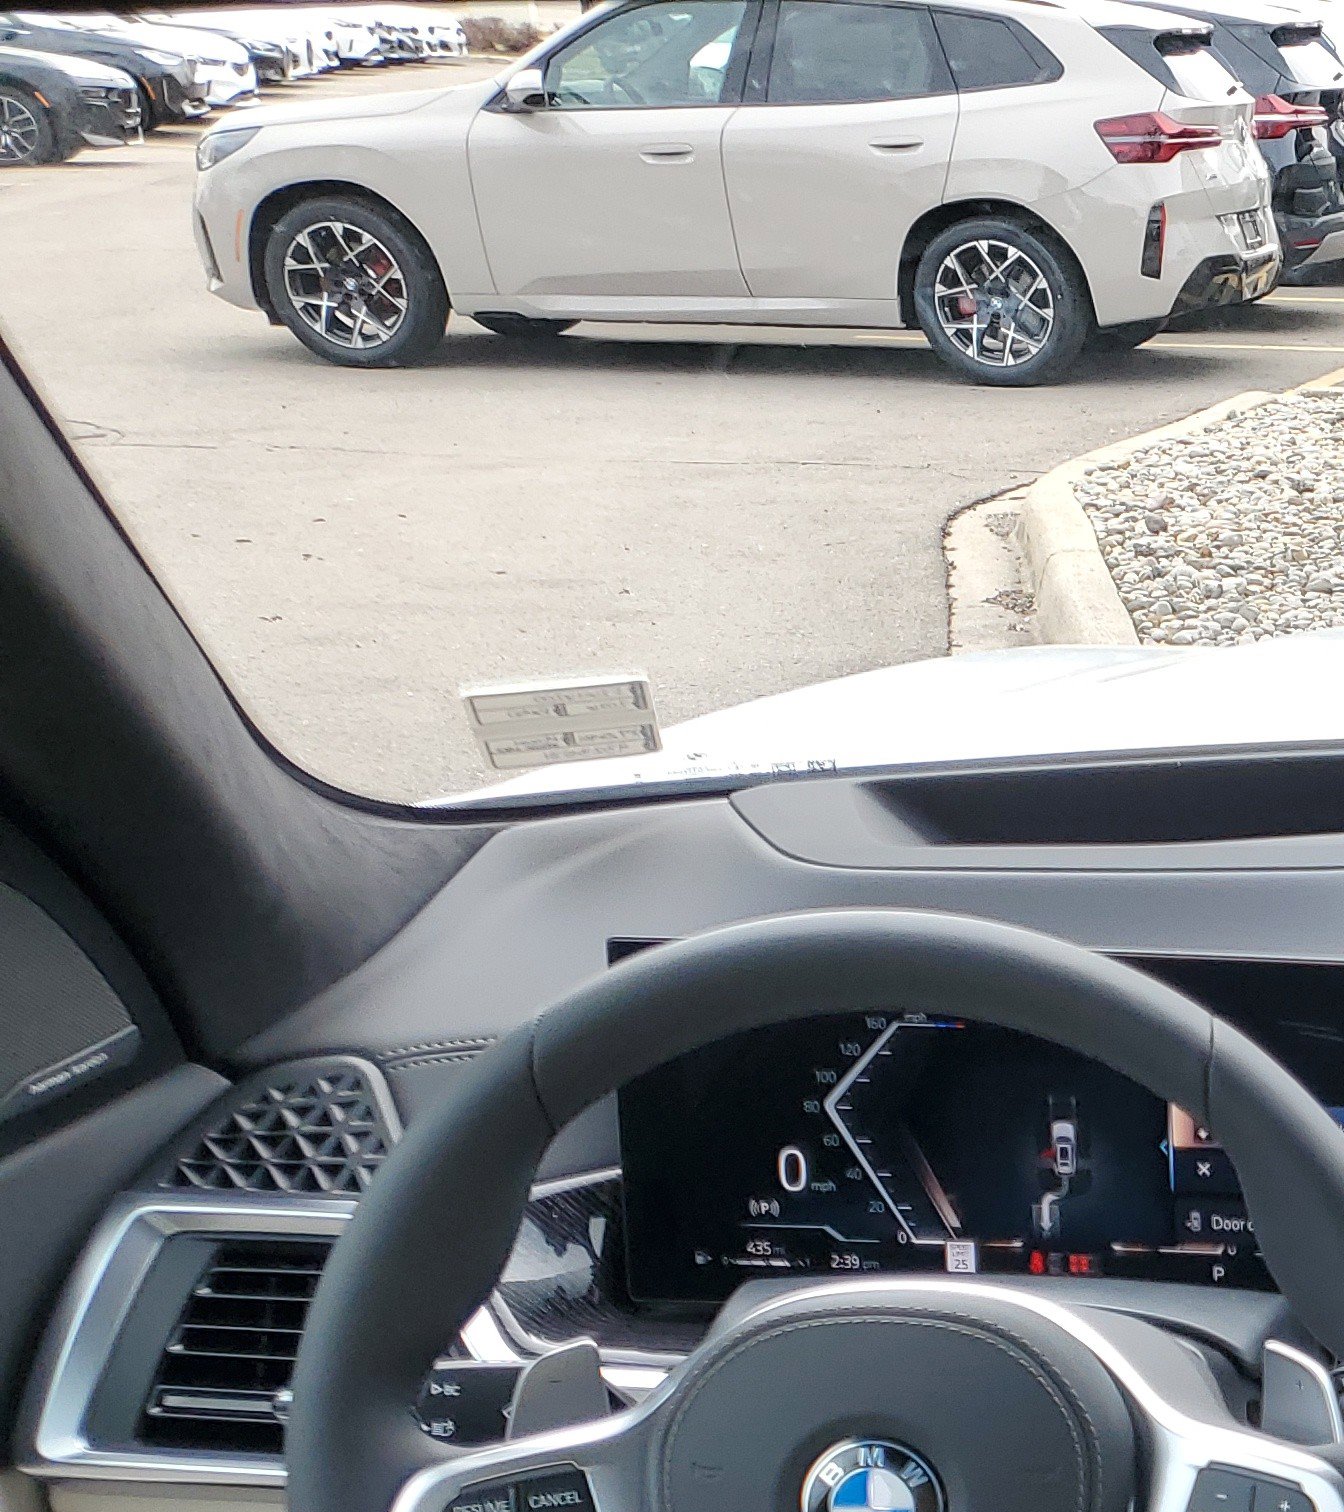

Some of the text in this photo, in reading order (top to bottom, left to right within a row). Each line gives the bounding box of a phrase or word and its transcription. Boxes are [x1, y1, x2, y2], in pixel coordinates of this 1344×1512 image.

[839, 1043, 861, 1056] 120
[815, 1070, 837, 1084] 100
[823, 1133, 840, 1147] 60
[777, 1146, 807, 1192] 0
[868, 1201, 884, 1213] 20
[1211, 1215, 1245, 1232] Door
[898, 1231, 907, 1244] 0
[746, 1241, 772, 1256] 435
[830, 1254, 860, 1269] 2:39
[954, 1258, 969, 1270] 25
[1212, 1265, 1225, 1281] P
[818, 1445, 929, 1488] BMW
[528, 1490, 583, 1509] CANCEL
